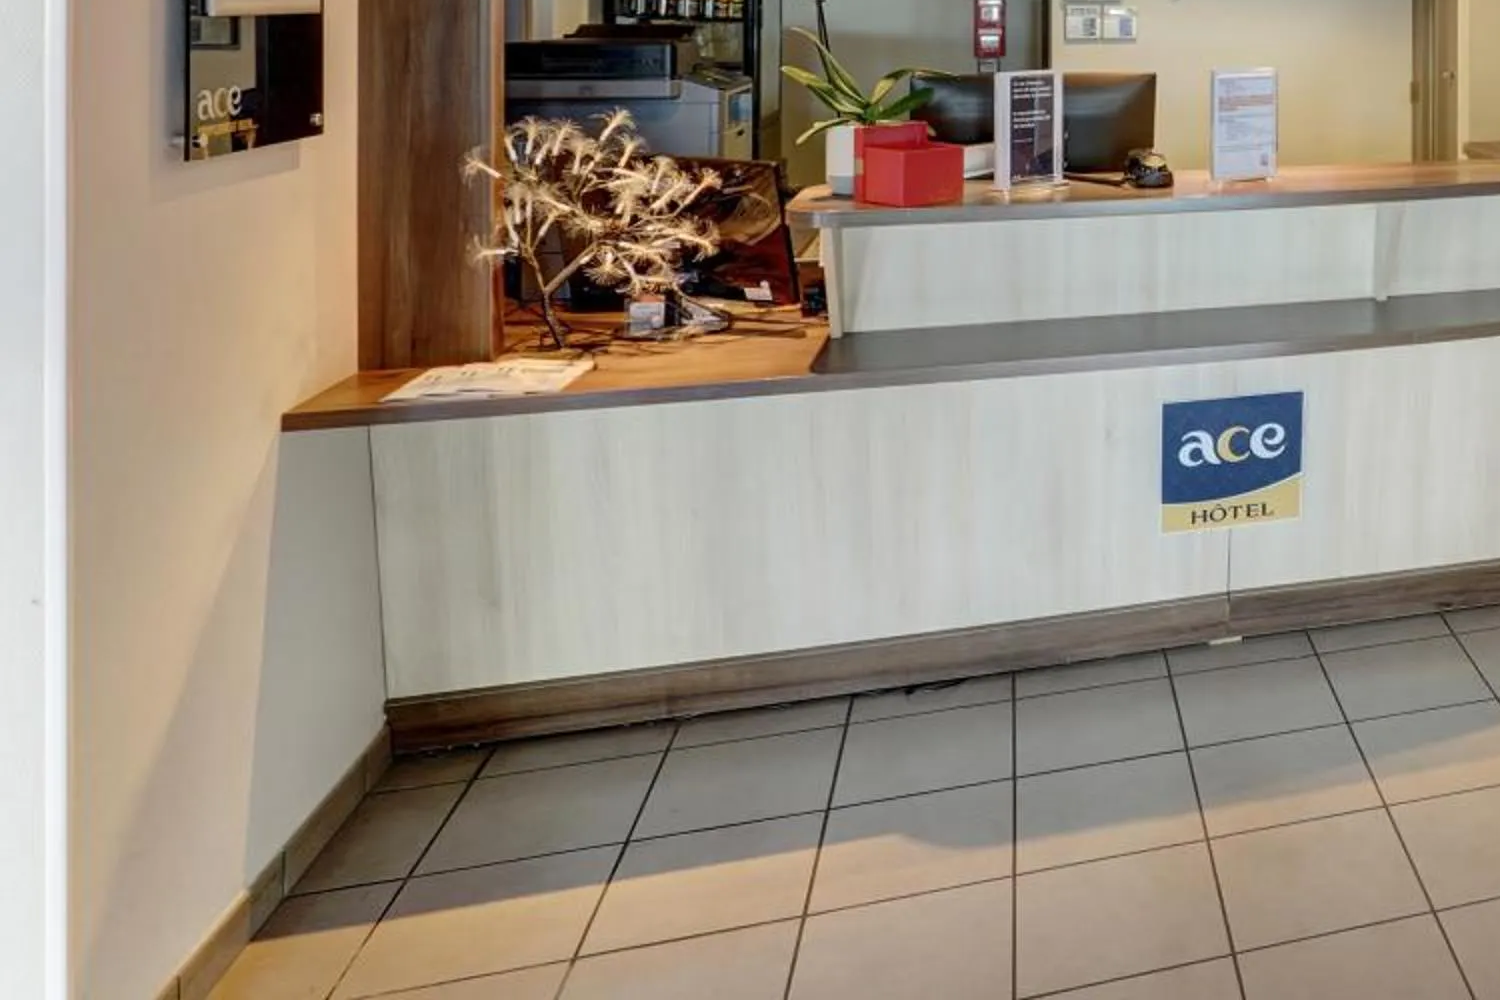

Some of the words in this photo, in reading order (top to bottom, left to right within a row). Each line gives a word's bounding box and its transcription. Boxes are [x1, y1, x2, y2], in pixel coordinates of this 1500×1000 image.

[197, 84, 242, 121] ace
[1178, 422, 1286, 467] ace
[1191, 501, 1275, 525] HÔTEL
